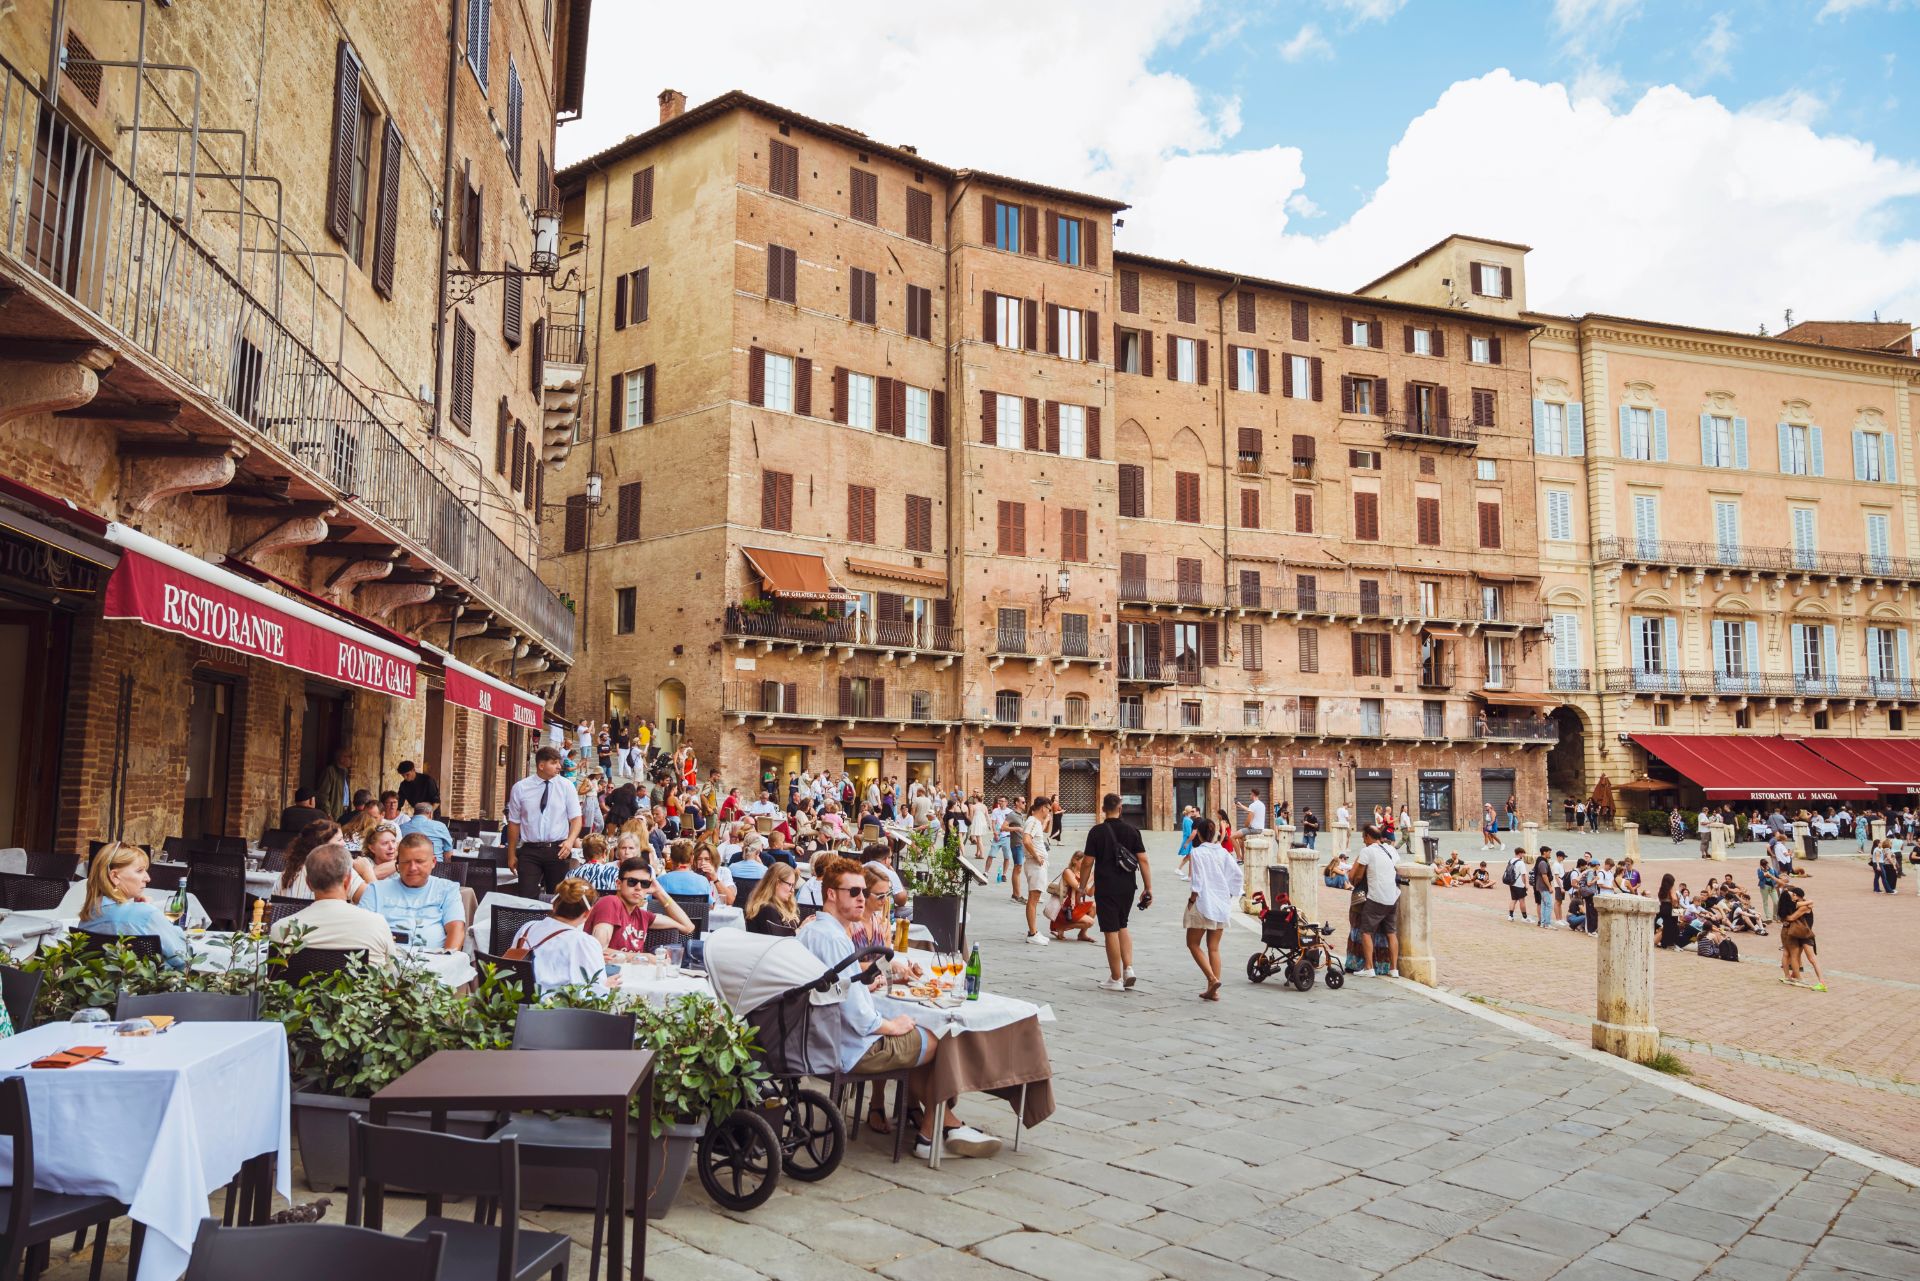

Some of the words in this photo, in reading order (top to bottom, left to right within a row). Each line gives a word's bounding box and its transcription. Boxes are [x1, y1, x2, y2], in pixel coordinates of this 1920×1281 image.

[163, 583, 284, 657] RISTORANTE
[337, 642, 383, 687] FONTE
[385, 659, 411, 695] GAIA
[478, 689, 492, 712] BAR
[1750, 792, 1793, 800] RISTORANTE
